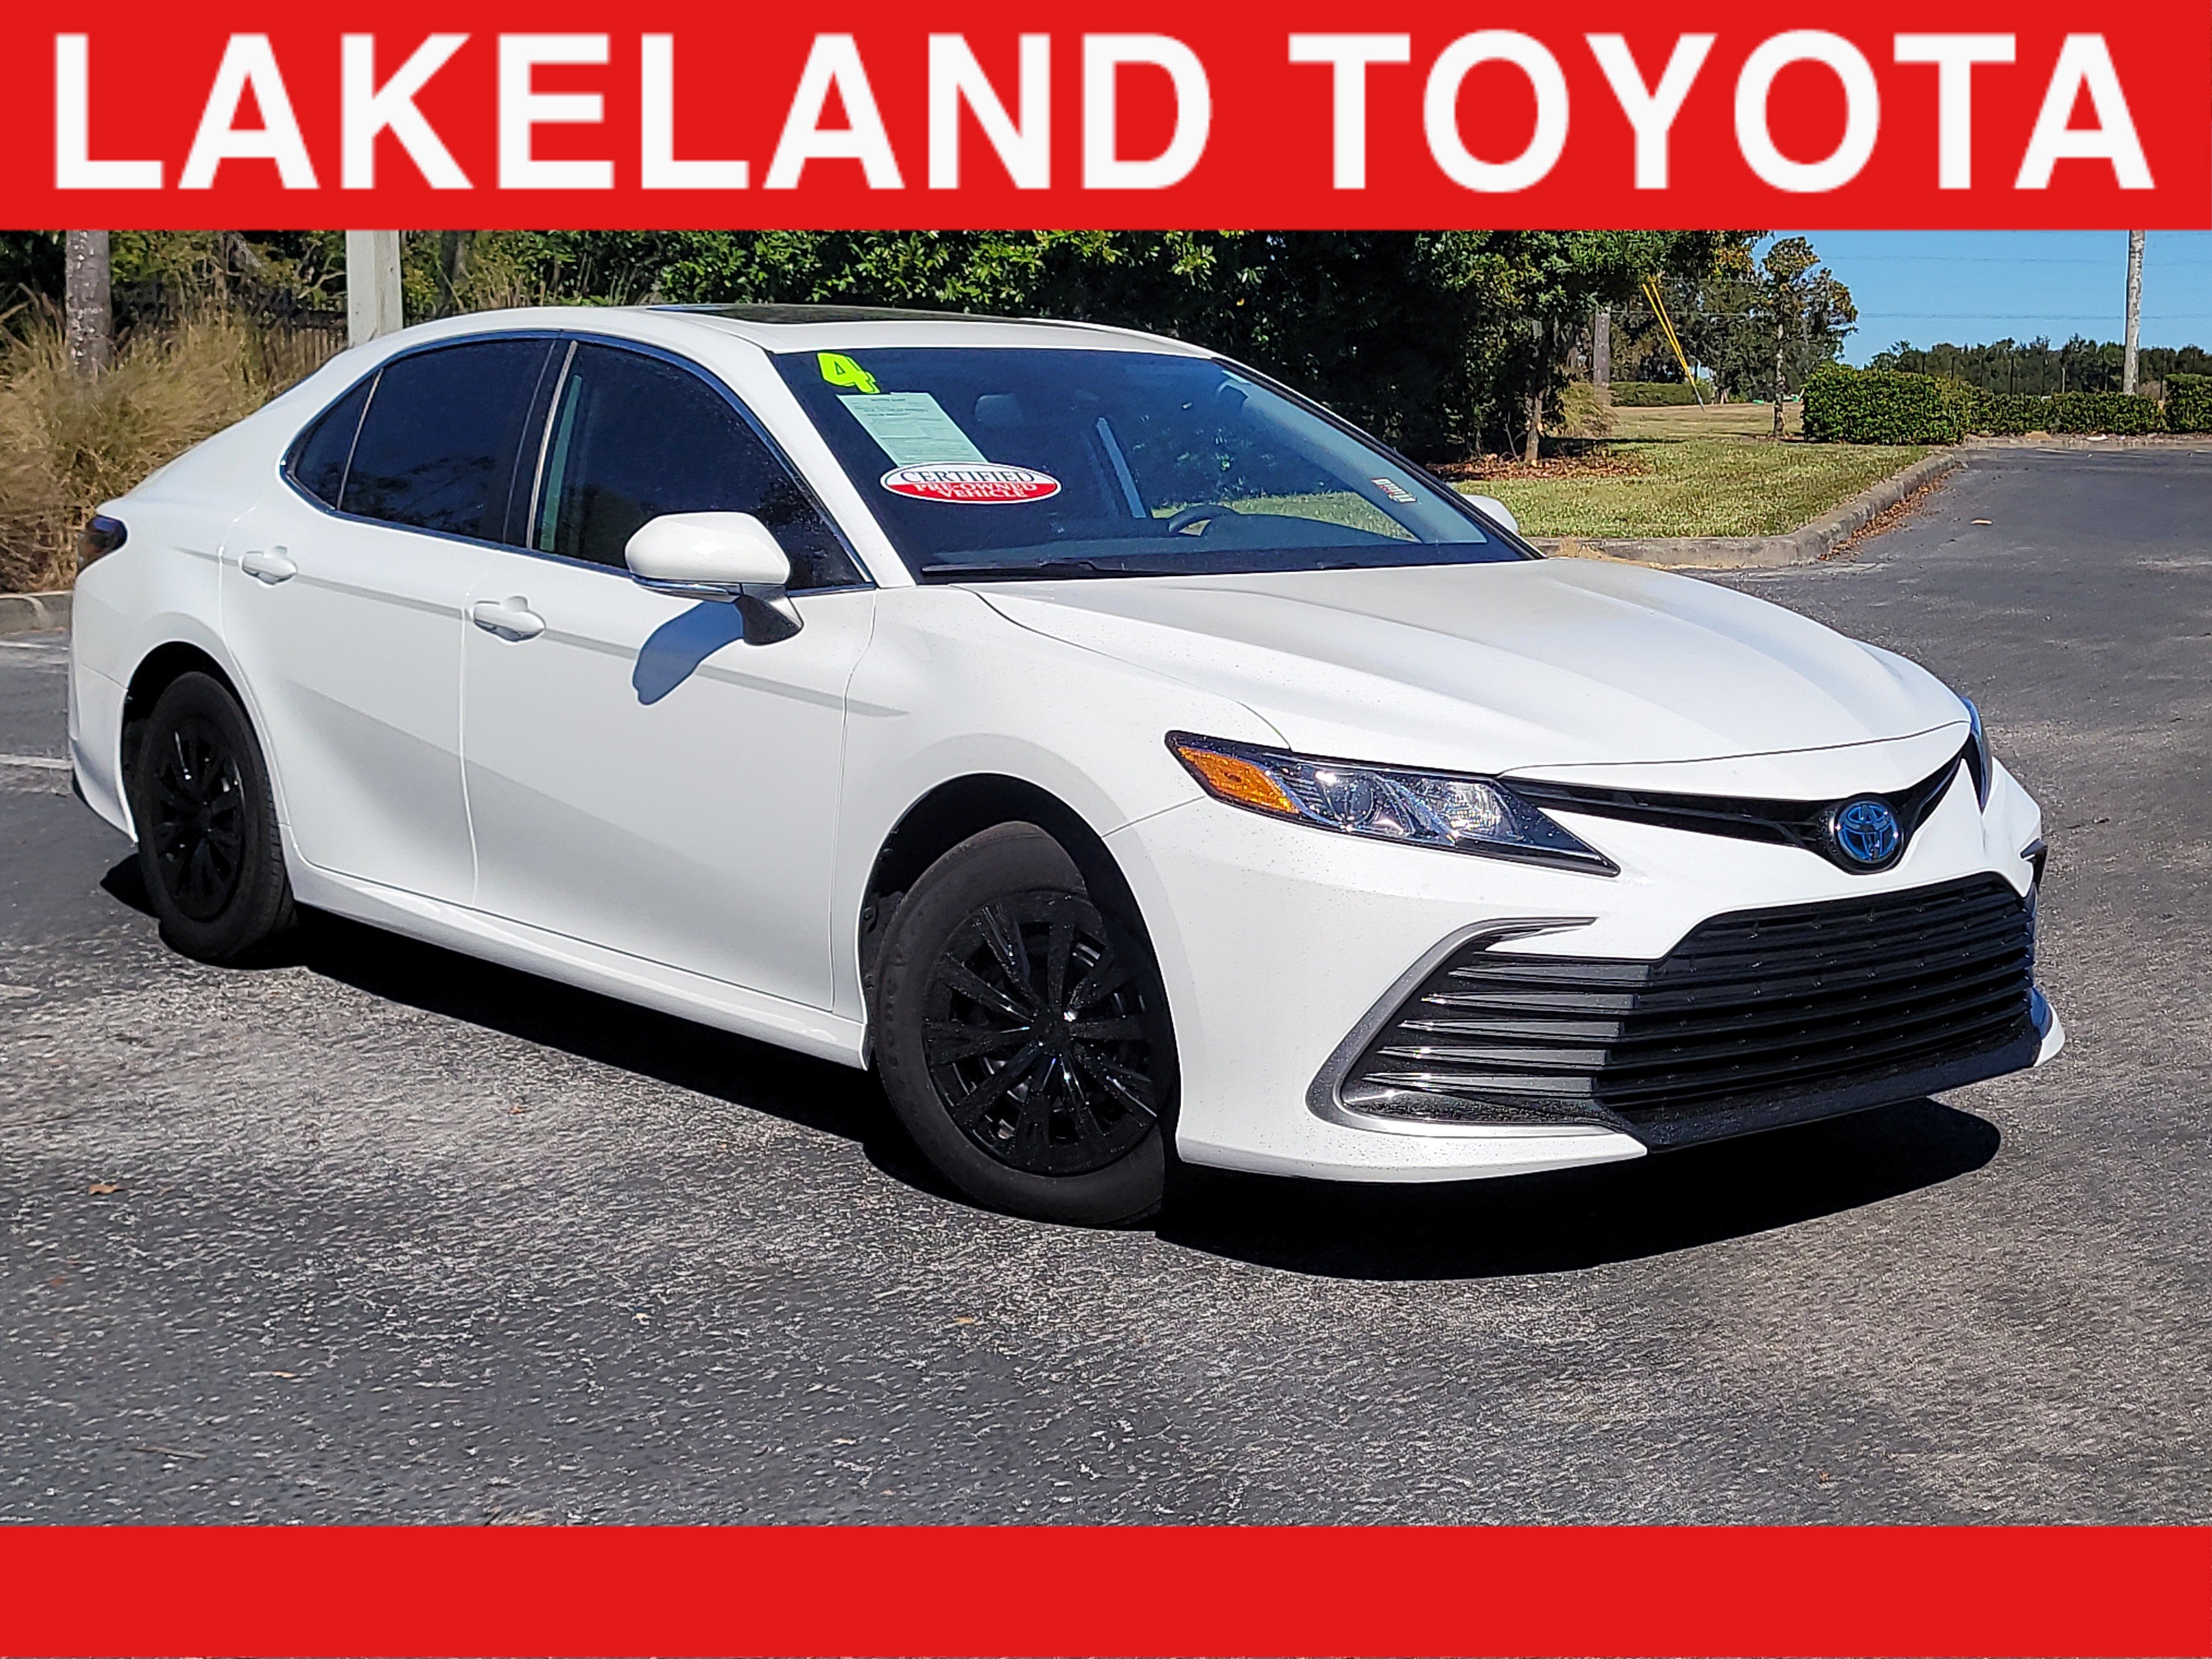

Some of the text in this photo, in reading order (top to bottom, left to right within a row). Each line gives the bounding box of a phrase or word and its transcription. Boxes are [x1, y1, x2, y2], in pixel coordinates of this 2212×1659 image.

[817, 352, 881, 394] 4
[900, 471, 1035, 482] CERTIFIED
[914, 483, 1038, 492] PRE-OWNED
[938, 489, 1029, 498] VEHICLE
